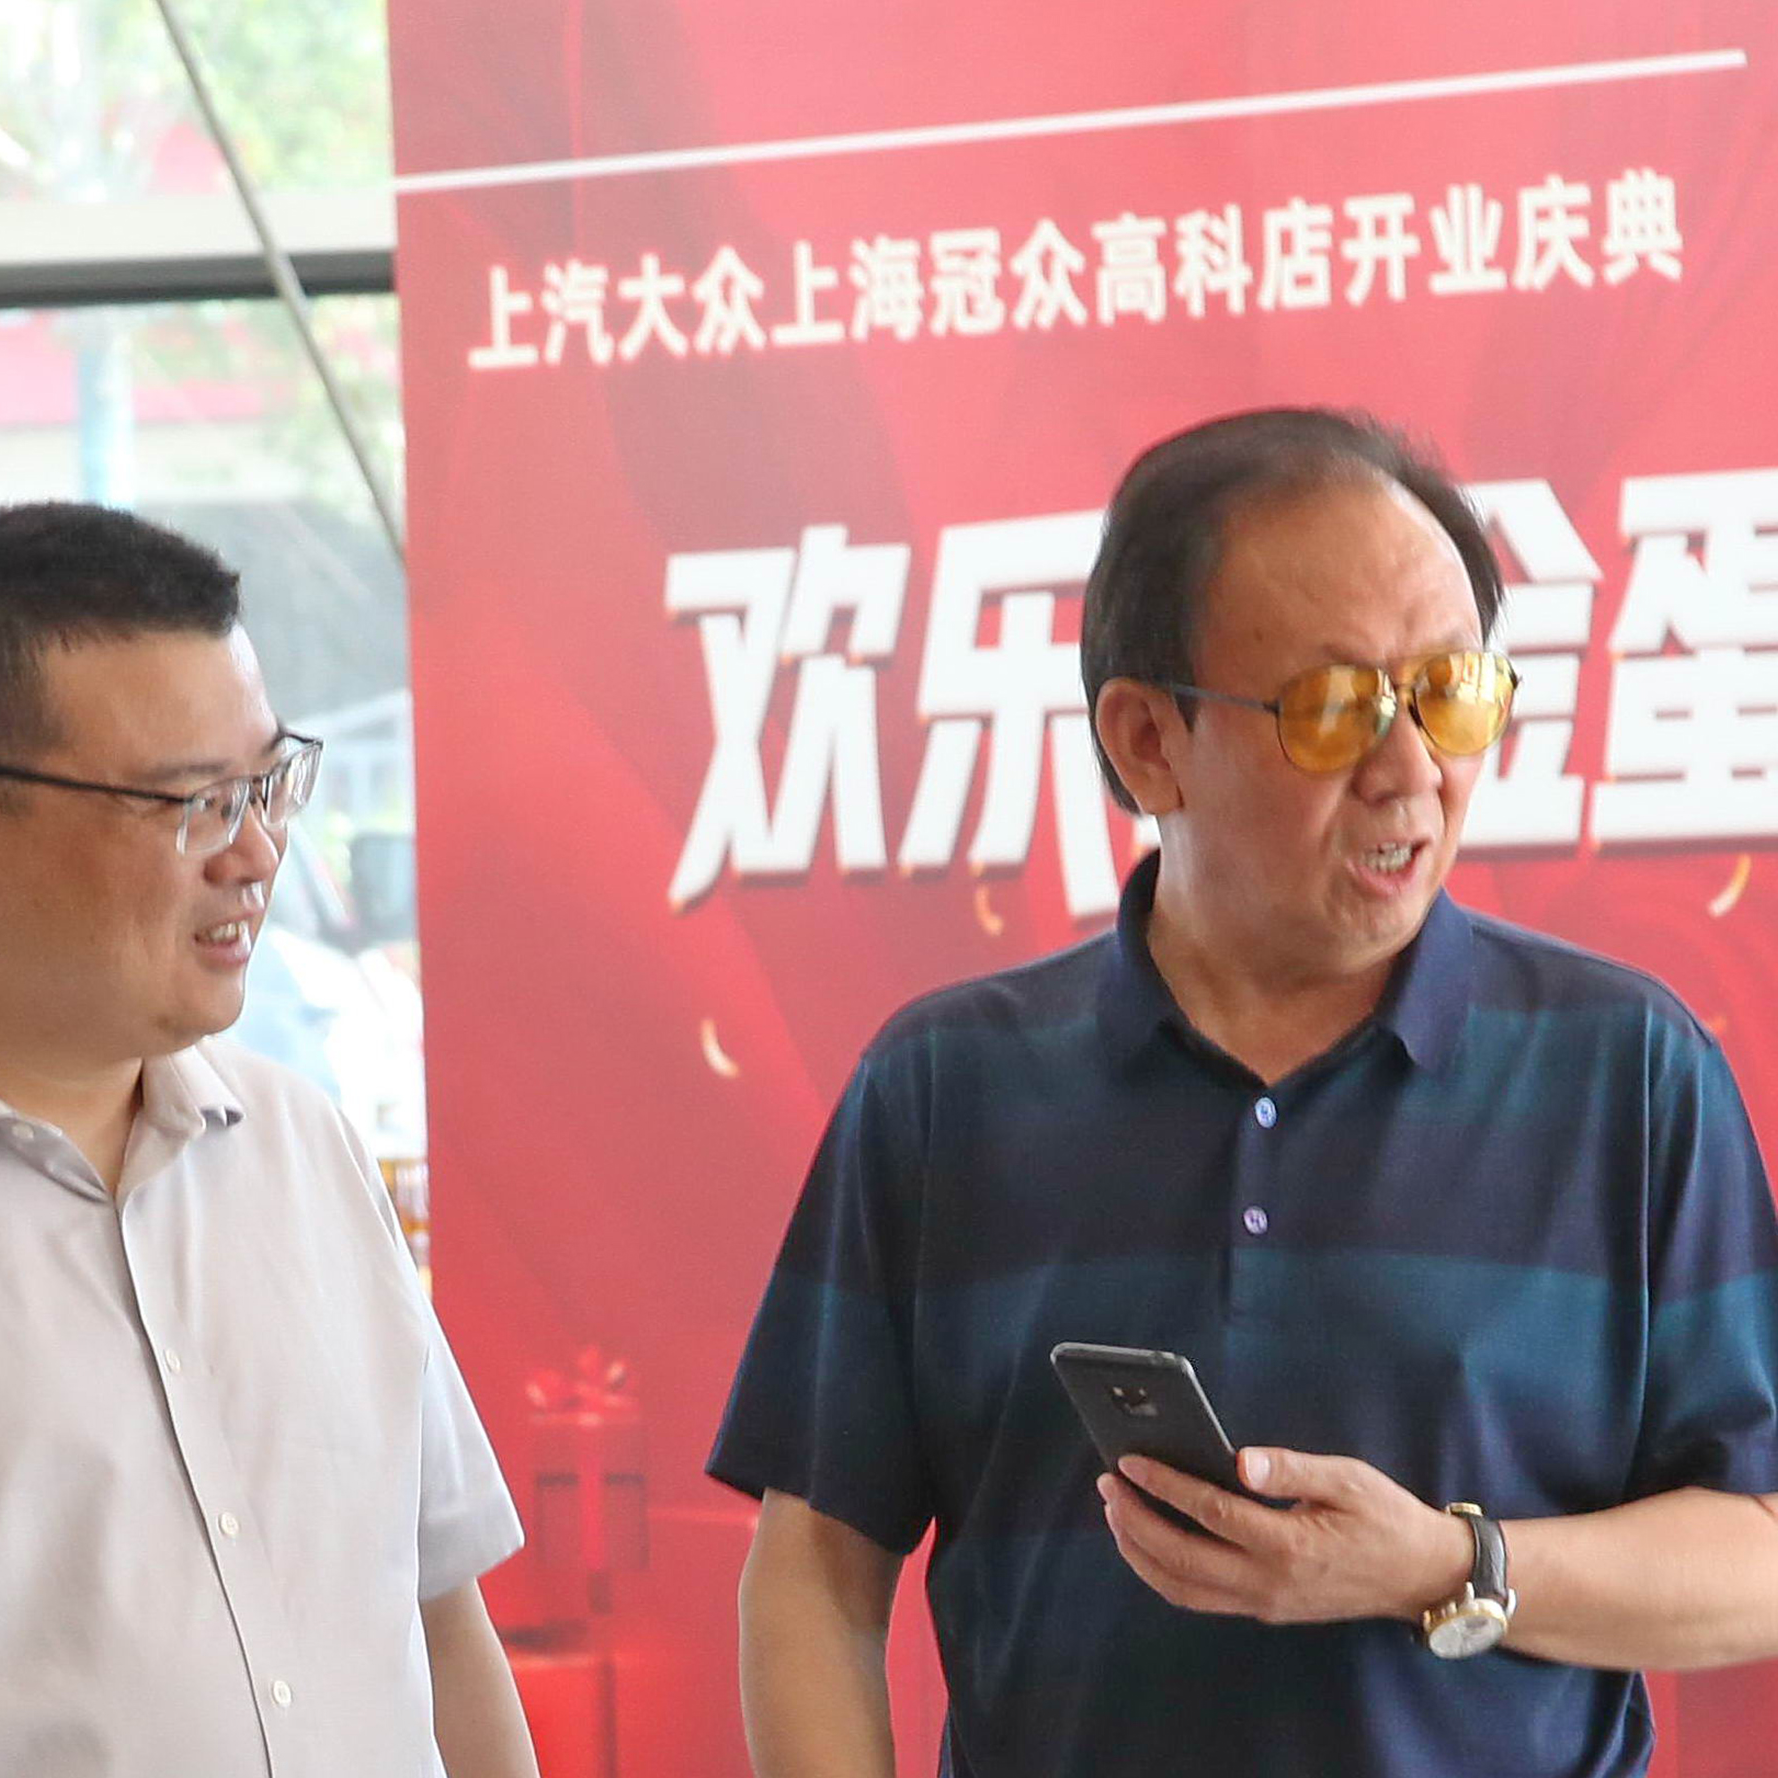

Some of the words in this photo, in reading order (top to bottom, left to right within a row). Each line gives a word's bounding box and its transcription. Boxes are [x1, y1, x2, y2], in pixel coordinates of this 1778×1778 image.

[467, 167, 1683, 370] 上汽大众上海冠众高科店开业庆典
